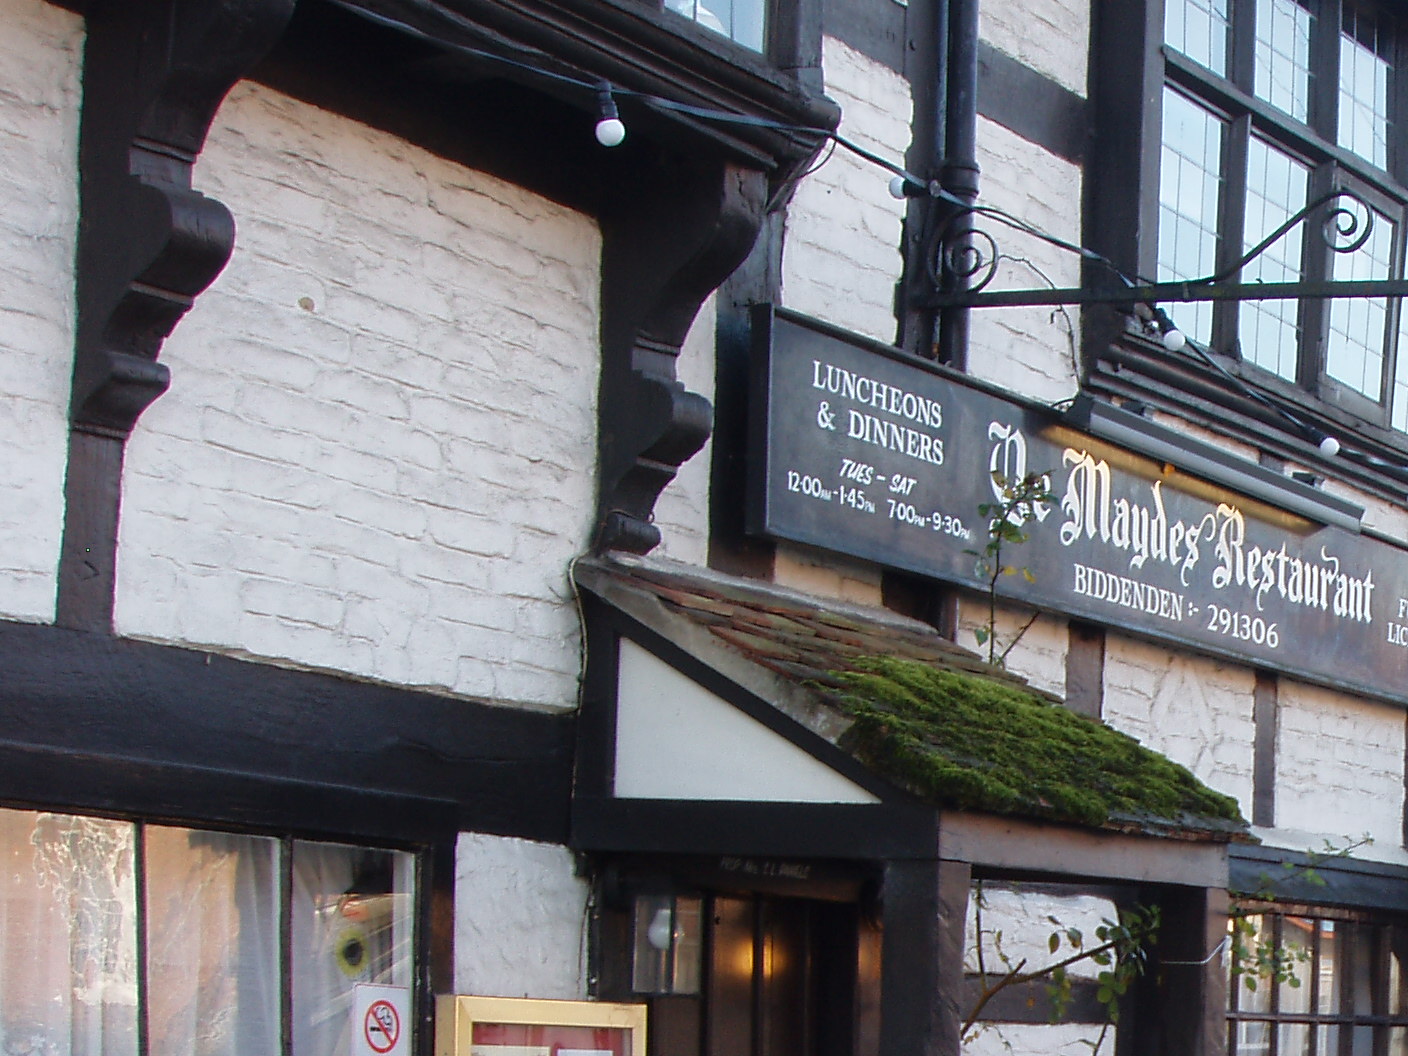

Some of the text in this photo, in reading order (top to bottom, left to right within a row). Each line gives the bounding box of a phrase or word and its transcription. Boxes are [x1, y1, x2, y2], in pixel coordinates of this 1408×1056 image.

[812, 360, 943, 428] LUNCHEONS
[816, 401, 944, 466] & DINNERS
[839, 459, 874, 485] TUES
[889, 474, 917, 496] SAT
[1060, 448, 1216, 587] Maydes
[1212, 503, 1375, 624] Restaurant
[1073, 563, 1184, 621] BIDDENDEN
[1207, 604, 1279, 648] 291306
